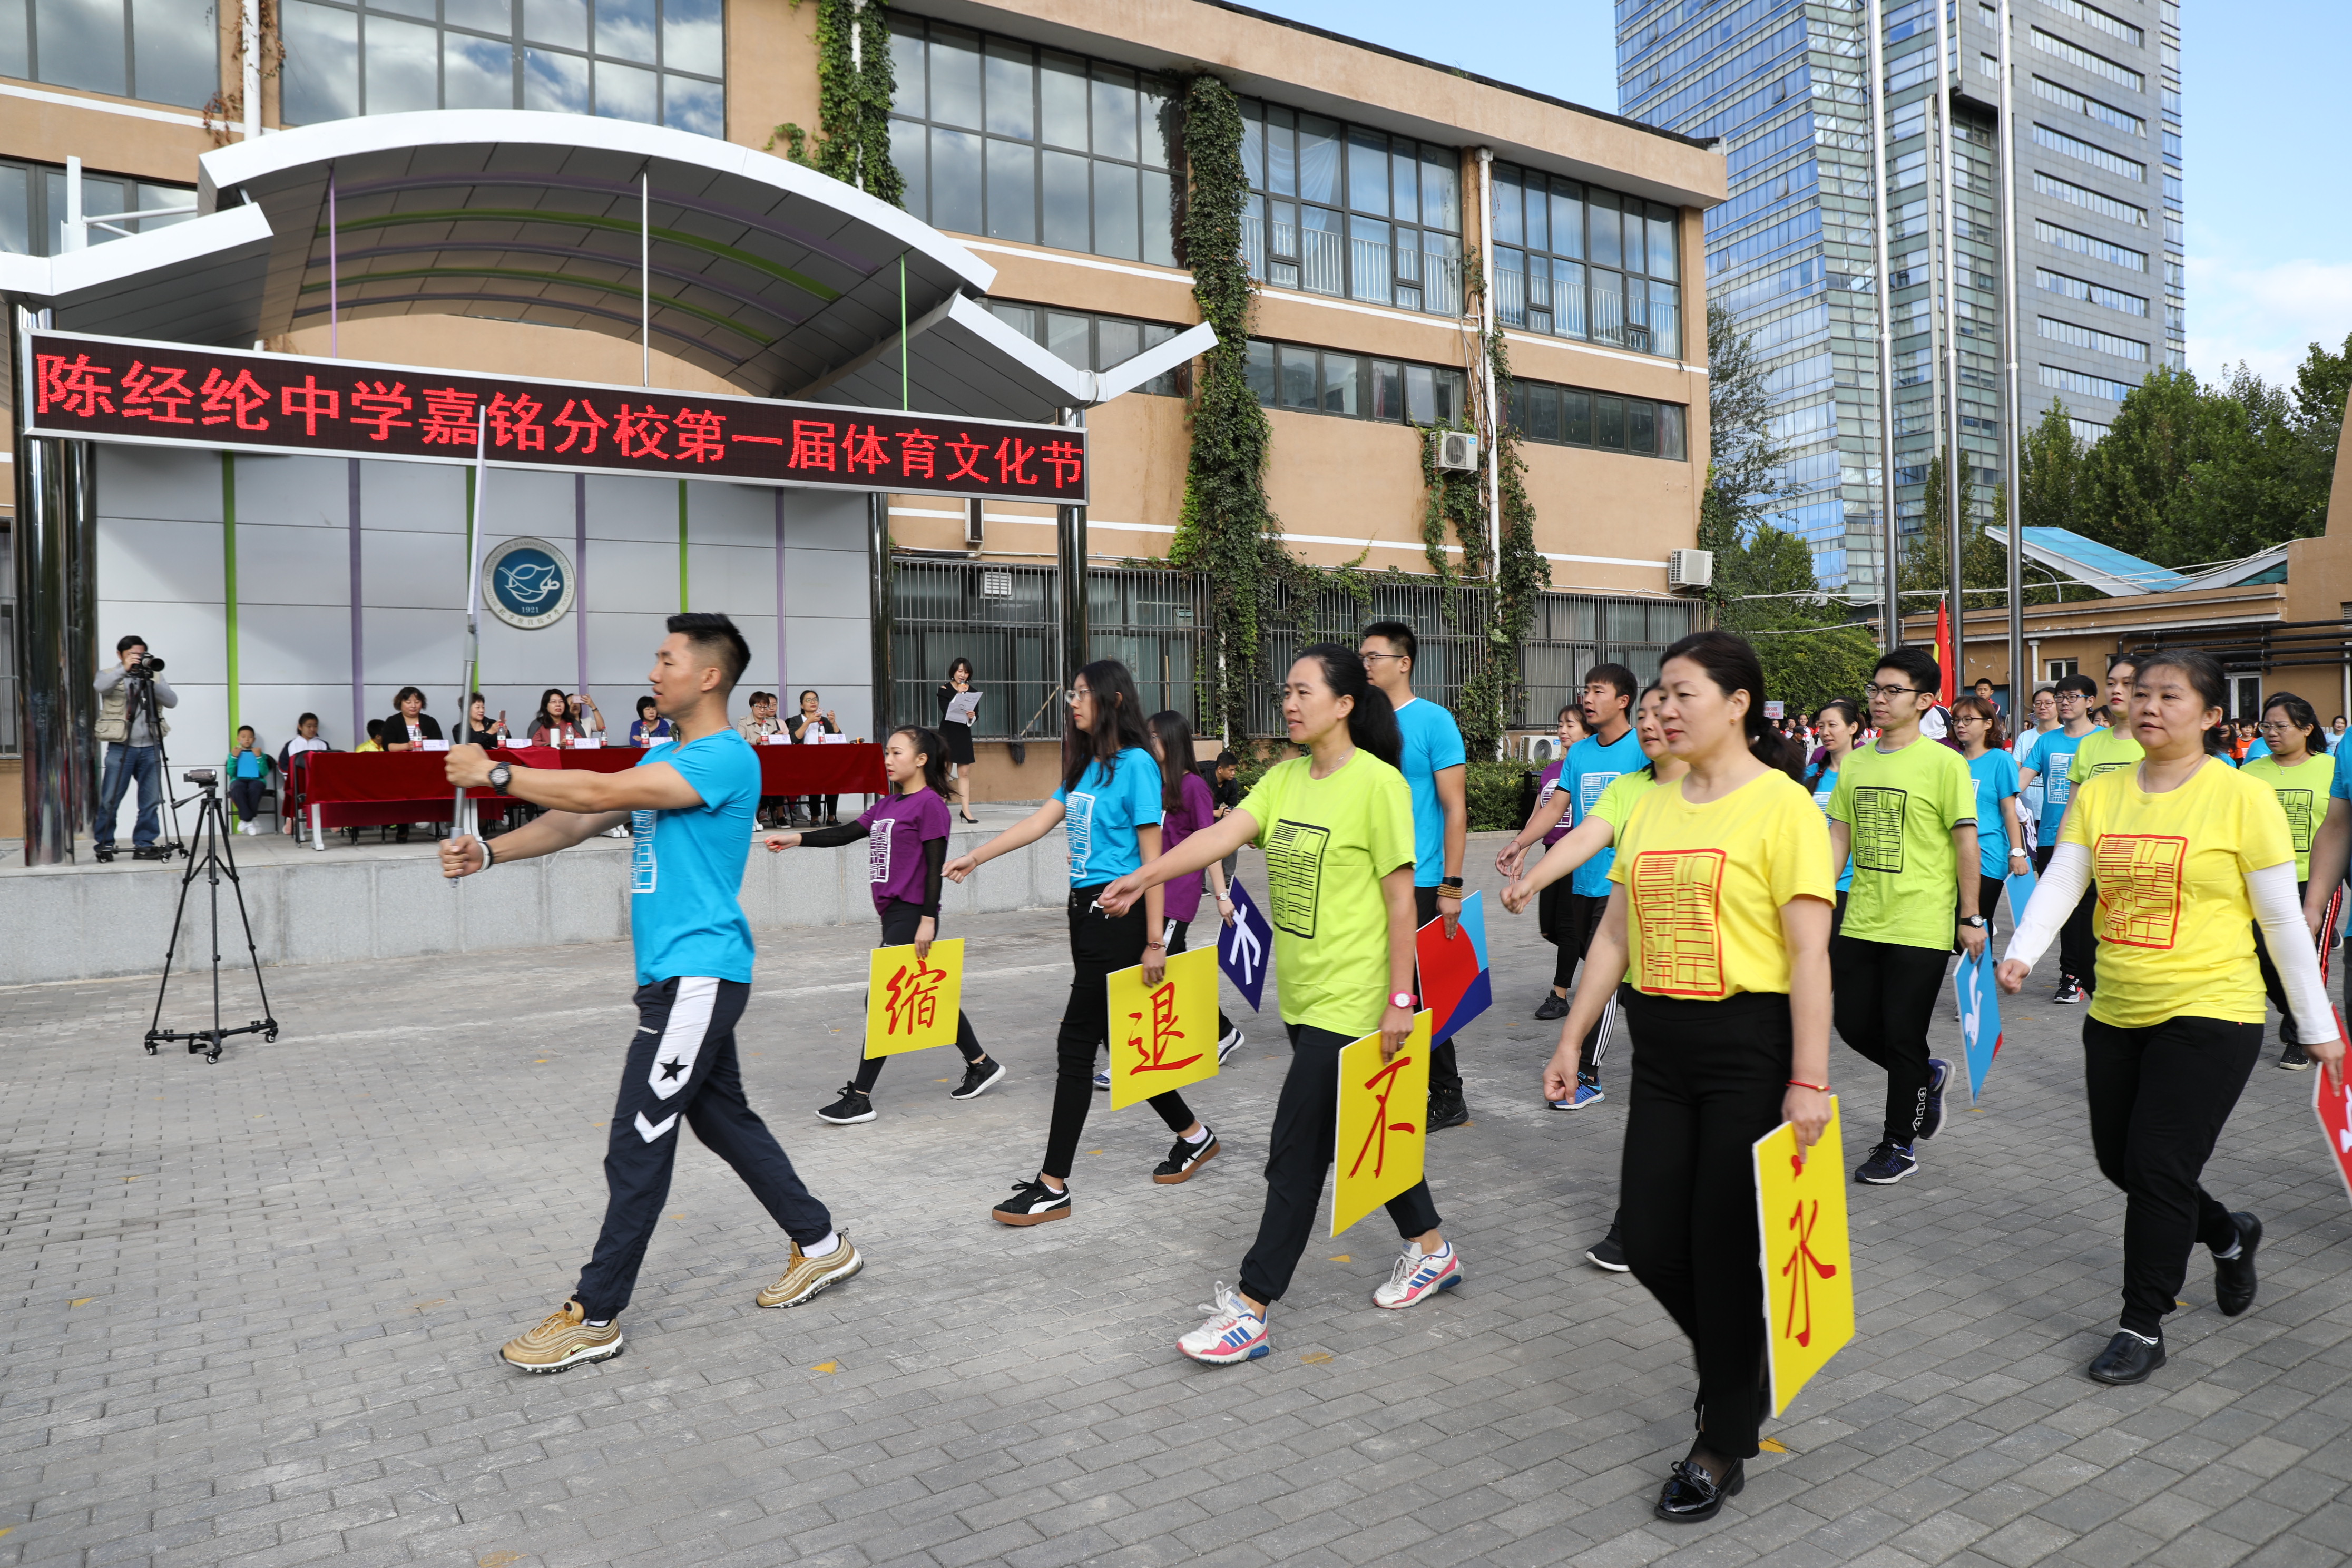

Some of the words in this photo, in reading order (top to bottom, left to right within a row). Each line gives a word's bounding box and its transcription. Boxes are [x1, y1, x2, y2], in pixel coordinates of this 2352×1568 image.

[37, 354, 1083, 489] 陈经纶中学嘉铭分校第一届体育文化节
[885, 958, 947, 1036] 缩
[1128, 982, 1203, 1076] 退
[1348, 1056, 1415, 1179] 不
[1230, 1298, 1244, 1311] adidas
